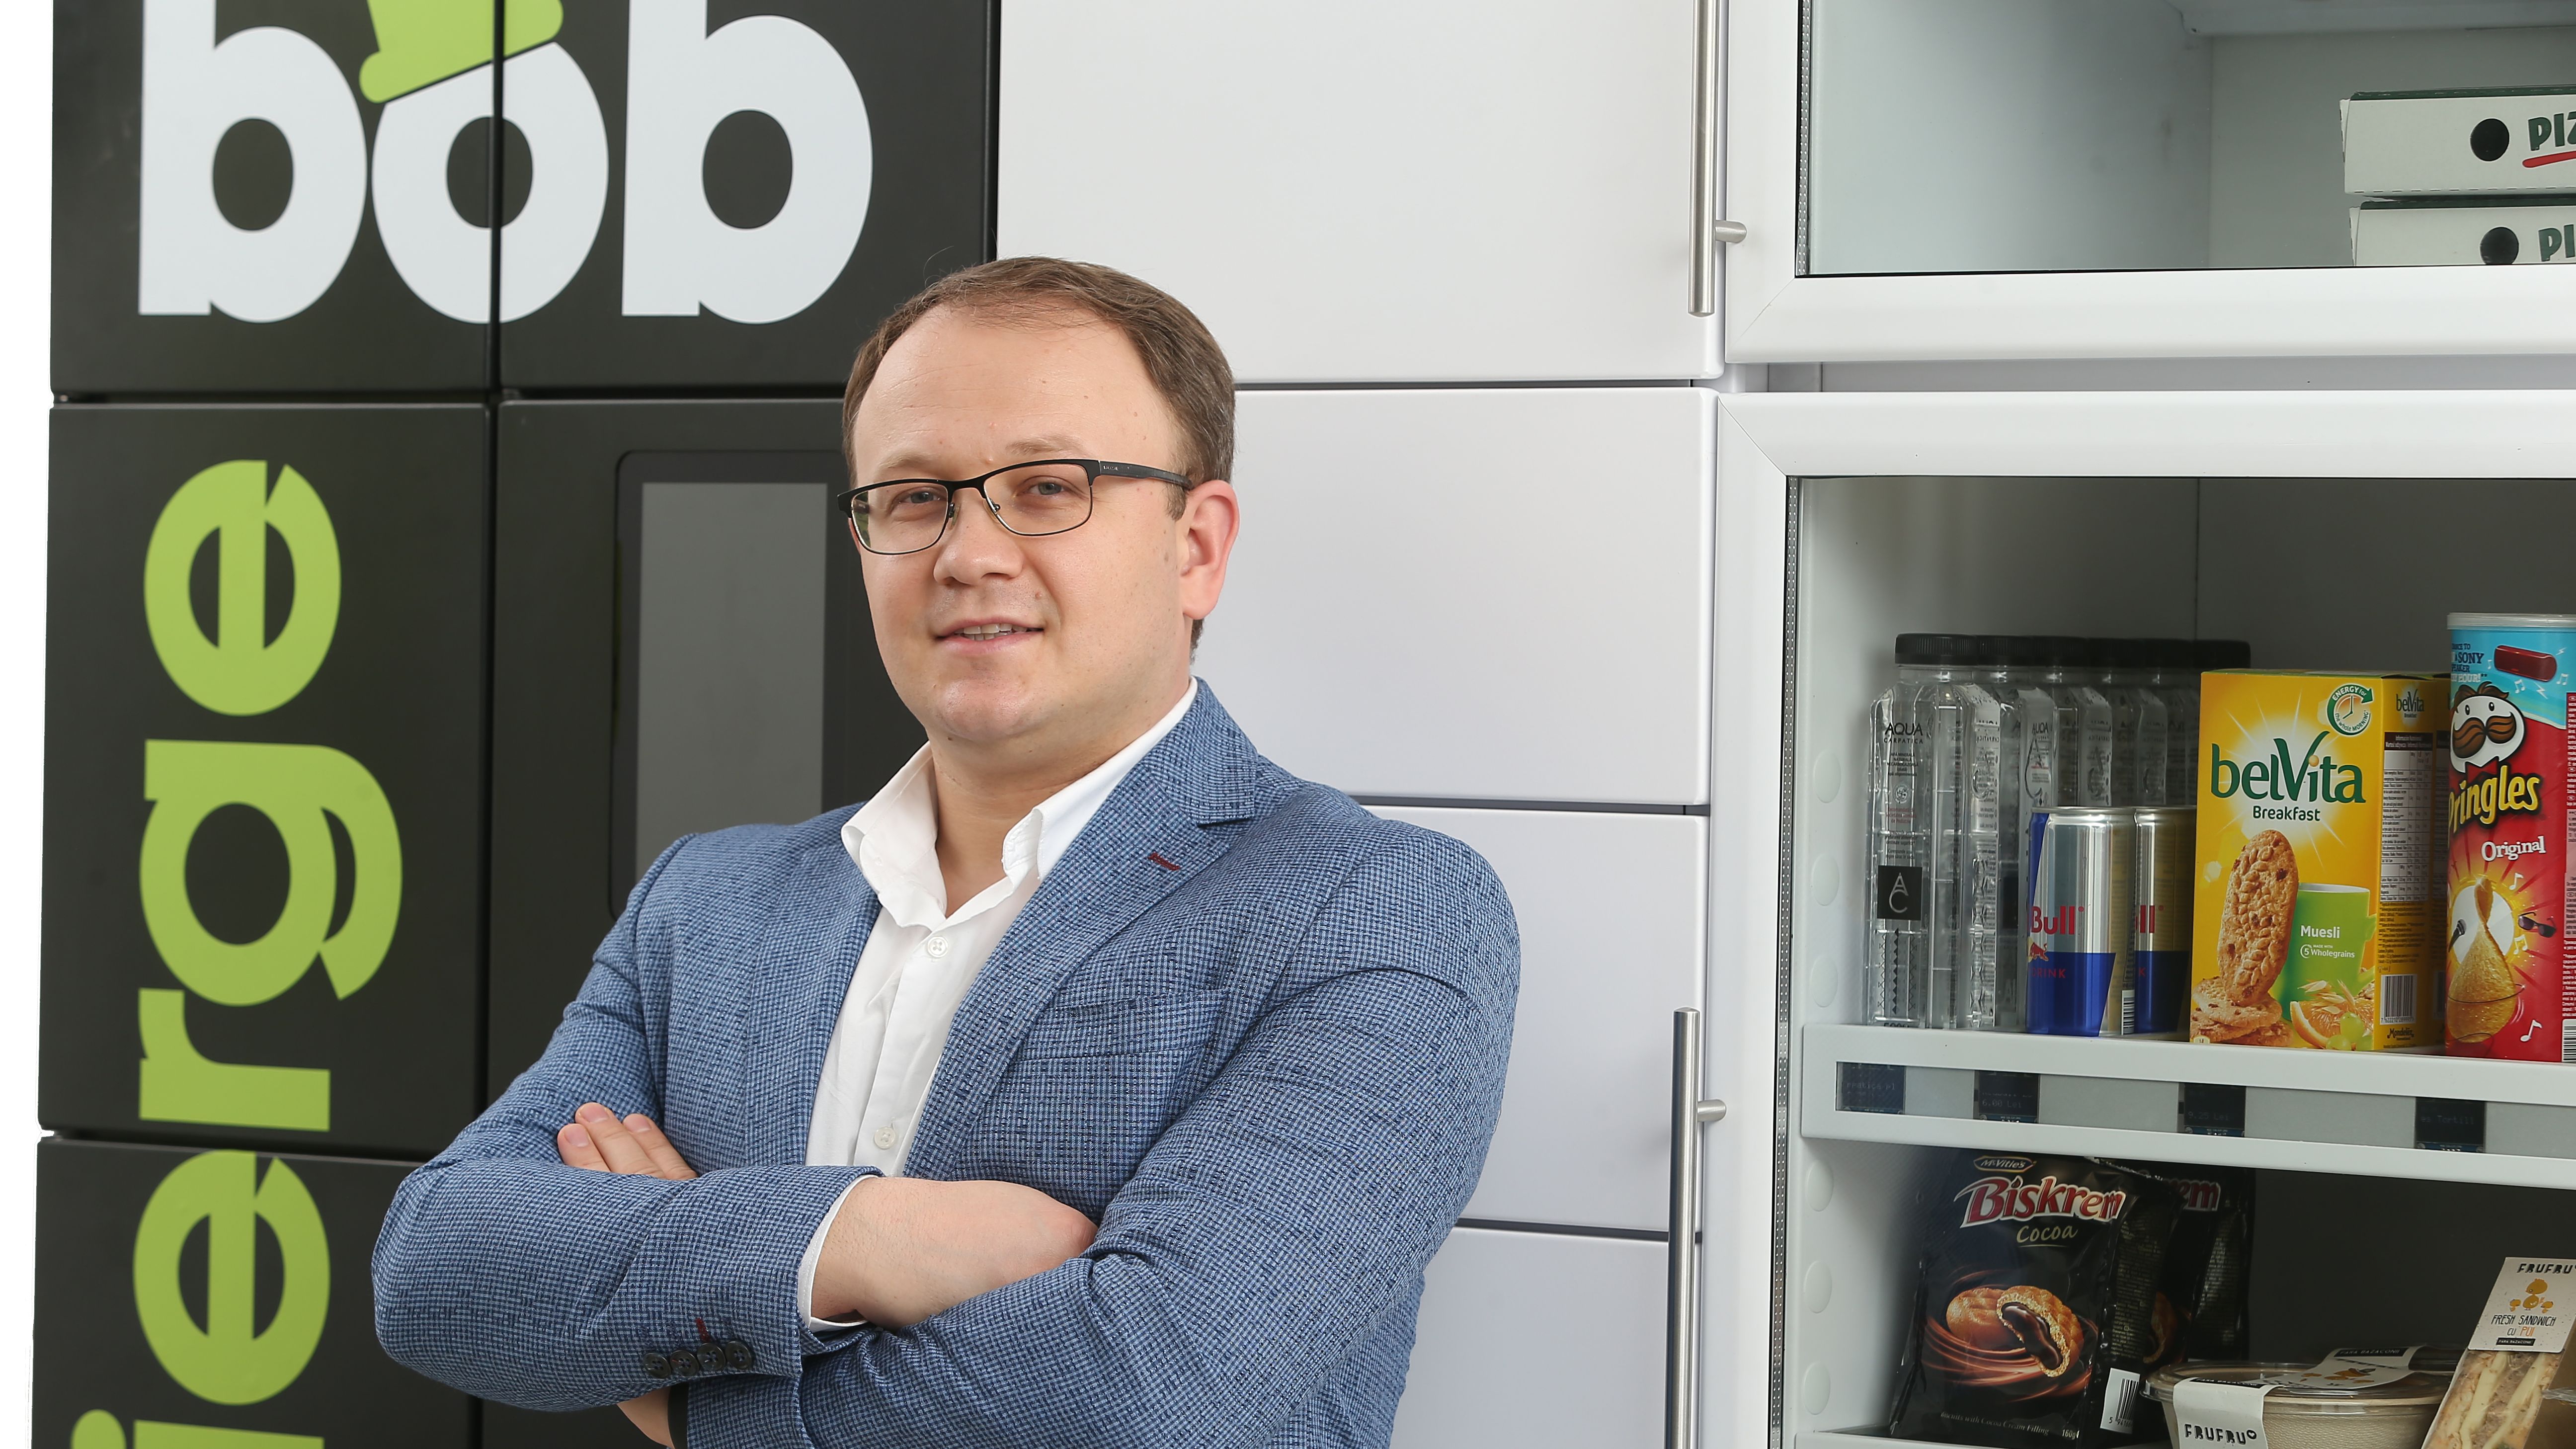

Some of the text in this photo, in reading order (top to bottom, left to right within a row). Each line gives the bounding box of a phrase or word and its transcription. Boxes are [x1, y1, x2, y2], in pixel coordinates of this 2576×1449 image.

[139, 0, 873, 323] bob
[2458, 652, 2484, 664] SONY
[2332, 686, 2359, 701] ENERGY
[2396, 689, 2424, 712] belVita
[1885, 723, 1923, 736] AQUA
[2338, 722, 2351, 732] whole
[2211, 730, 2366, 804] belVita
[2448, 765, 2541, 846] Pringles
[2253, 806, 2321, 821] Breakfast
[2481, 835, 2546, 862] Original
[2031, 906, 2075, 935] Bull
[2301, 925, 2340, 938] Muesli
[2311, 949, 2355, 959] Wholegrains
[1980, 1159, 2026, 1168] McVitie's
[1955, 1176, 2126, 1228] Biskrem
[2016, 1223, 2078, 1243] Cocoa
[2516, 1264, 2573, 1274] FRUFRU
[2491, 1315, 2557, 1326] FRESH SANDWICH
[2520, 1326, 2535, 1337] PUI
[1981, 1418, 2002, 1427] Cocoa
[2004, 1420, 2025, 1430] Cream
[2027, 1425, 2049, 1436] Filling
[2062, 1429, 2076, 1440] 160g
[2184, 1424, 2246, 1445] FRUFRU
